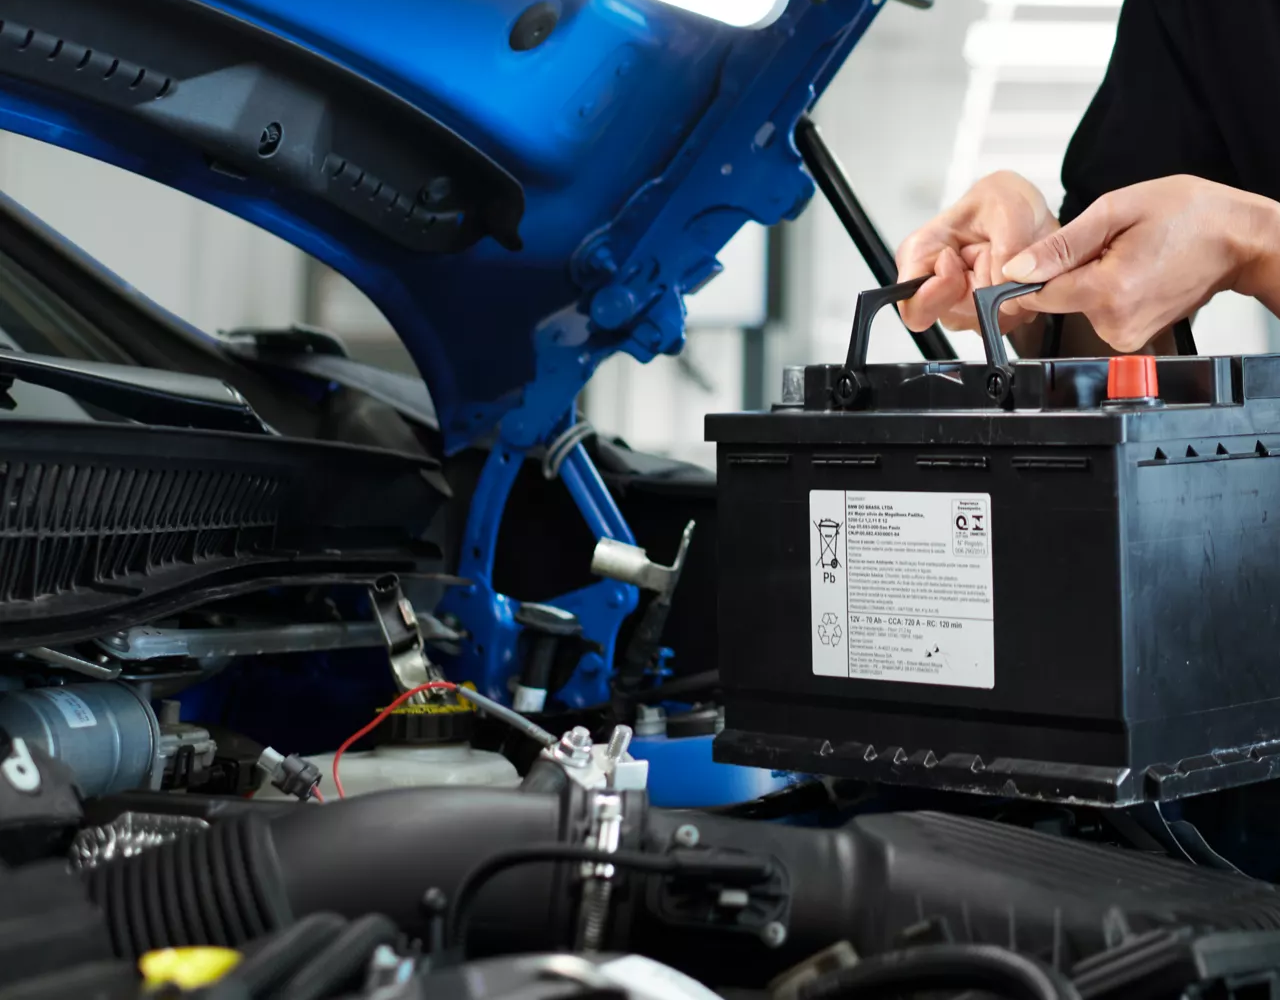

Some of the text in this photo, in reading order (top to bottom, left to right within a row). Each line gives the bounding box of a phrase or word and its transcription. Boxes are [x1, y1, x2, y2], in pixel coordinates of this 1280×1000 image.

[823, 571, 836, 584] Pb
[850, 615, 861, 623] 12V
[866, 616, 873, 624] 70
[873, 616, 882, 625] Ah
[888, 617, 904, 626] CCA:
[905, 618, 915, 626] 720
[939, 620, 950, 629] 120
[950, 622, 963, 630] min
